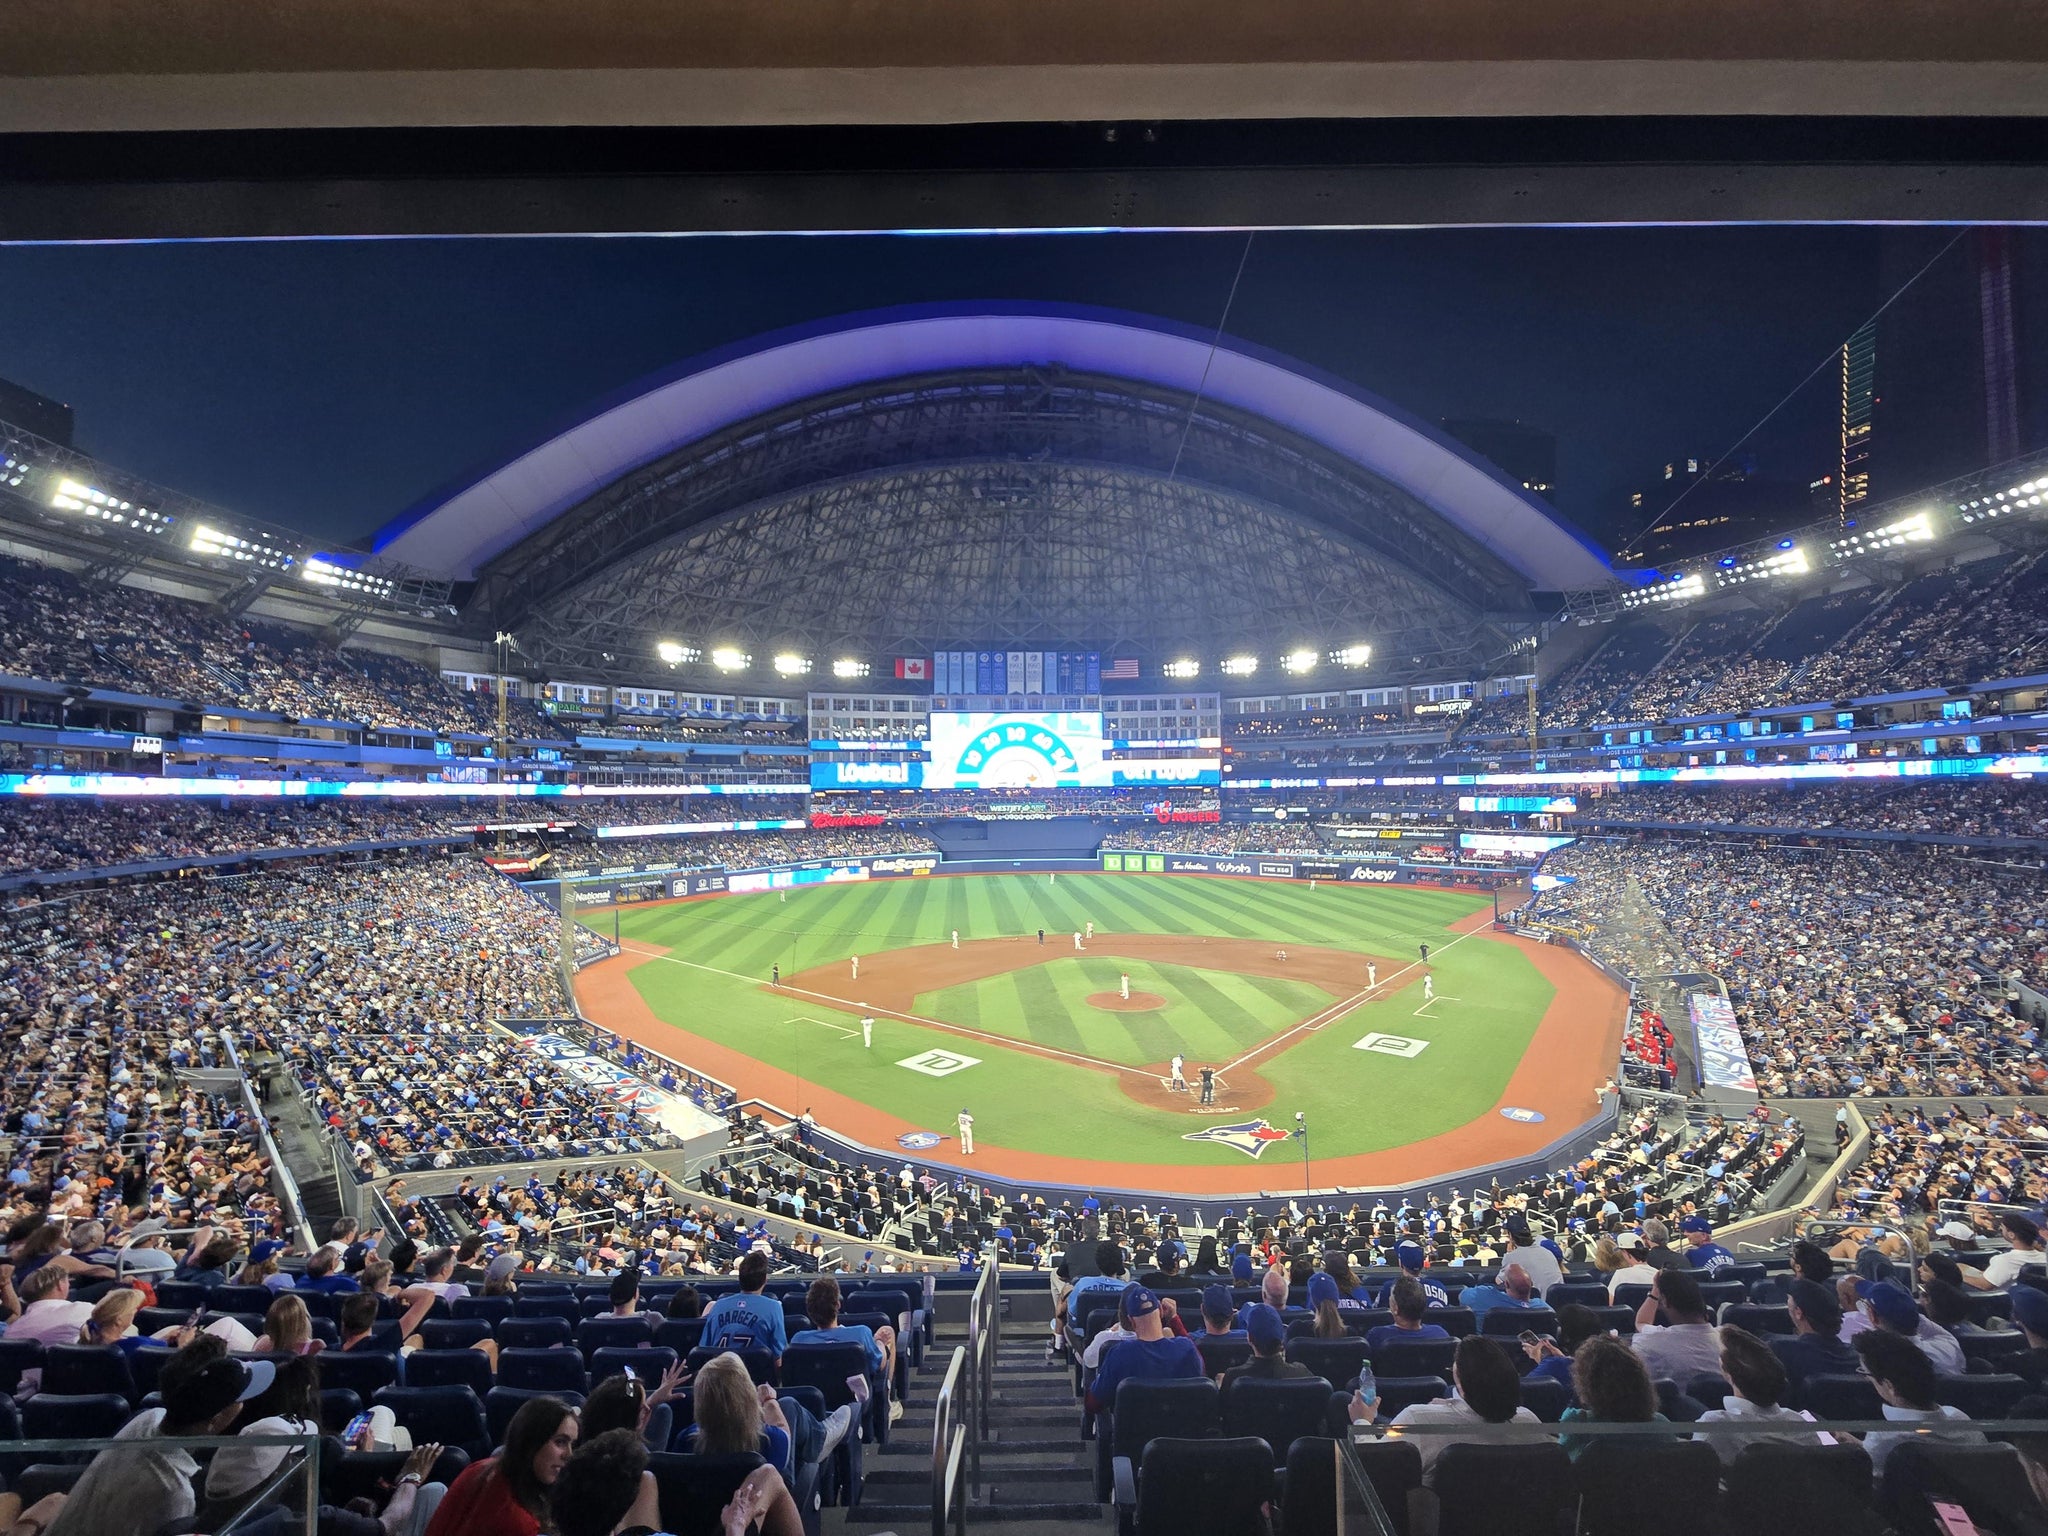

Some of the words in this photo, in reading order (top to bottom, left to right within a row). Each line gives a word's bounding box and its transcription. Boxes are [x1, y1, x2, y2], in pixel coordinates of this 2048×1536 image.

[1440, 702, 1473, 712] ROOFTOP
[837, 762, 909, 783] LOUDER!
[989, 804, 1022, 813] WESTJET
[810, 812, 885, 828] Budweiser
[1172, 811, 1221, 822] ROGERS
[600, 866, 635, 876] SUBWAY
[645, 863, 678, 872] SUBWAY
[872, 858, 936, 872] theScore
[1172, 861, 1185, 870] Tim
[1185, 861, 1208, 871] Hortons
[1216, 862, 1251, 874] Kubota
[1350, 866, 1397, 882] Sobeys
[575, 889, 610, 902] National
[917, 1053, 963, 1070] TD
[717, 1310, 759, 1329] BARGER
[719, 1333, 756, 1348] 47
